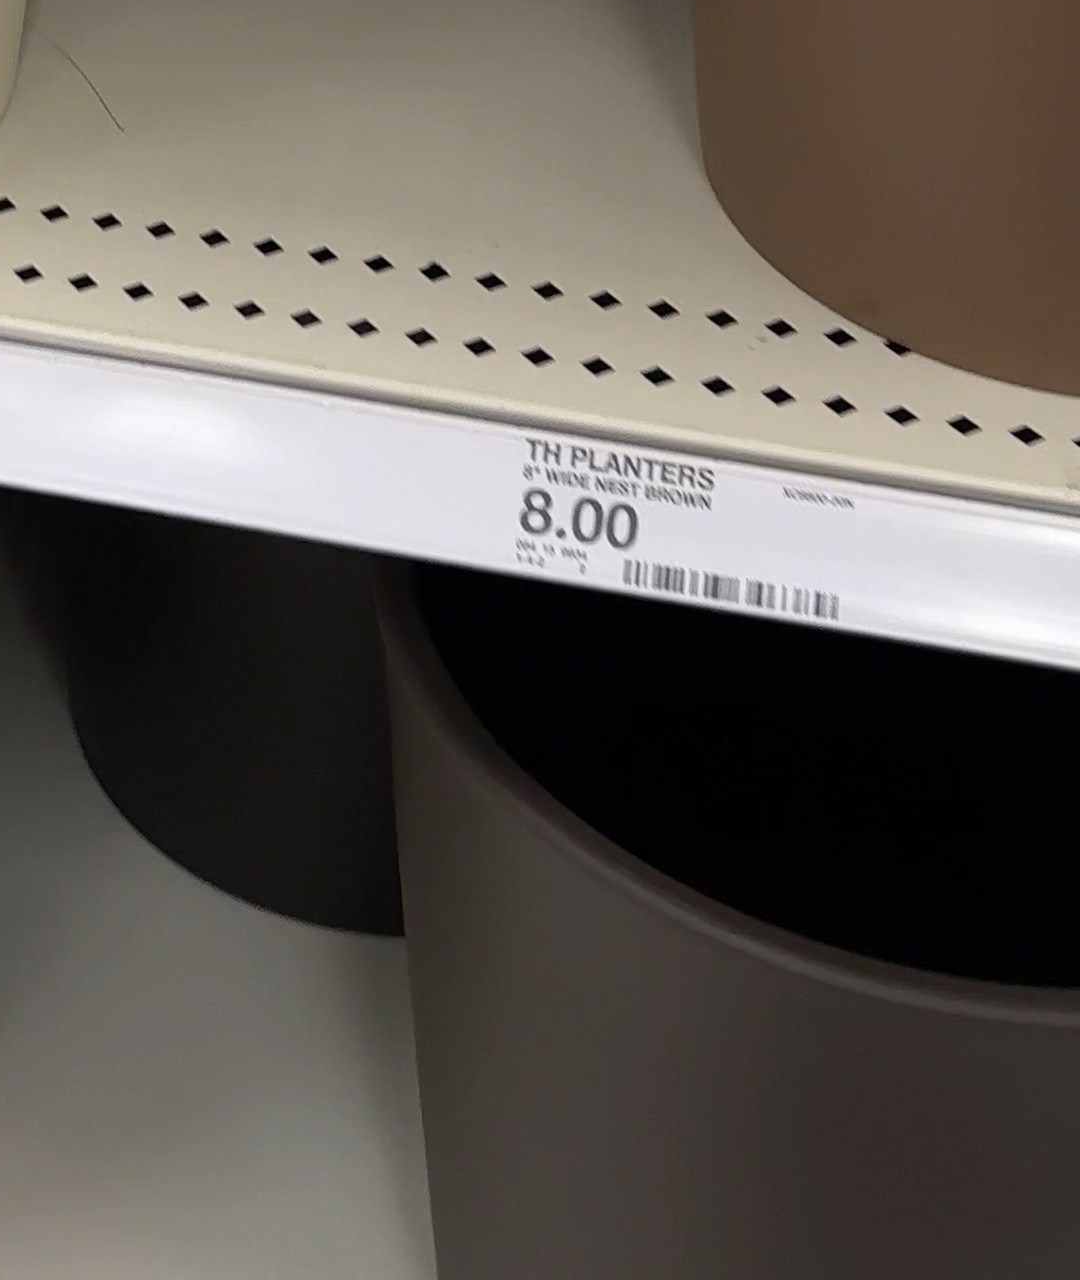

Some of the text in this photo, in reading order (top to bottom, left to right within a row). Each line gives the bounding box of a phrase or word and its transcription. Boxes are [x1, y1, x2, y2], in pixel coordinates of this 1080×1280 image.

[526, 438, 716, 490] TH PLANTERS
[545, 468, 590, 490] WIDE
[595, 476, 642, 498] NEST
[644, 486, 713, 511] BROWN
[520, 488, 638, 549] 8.00
